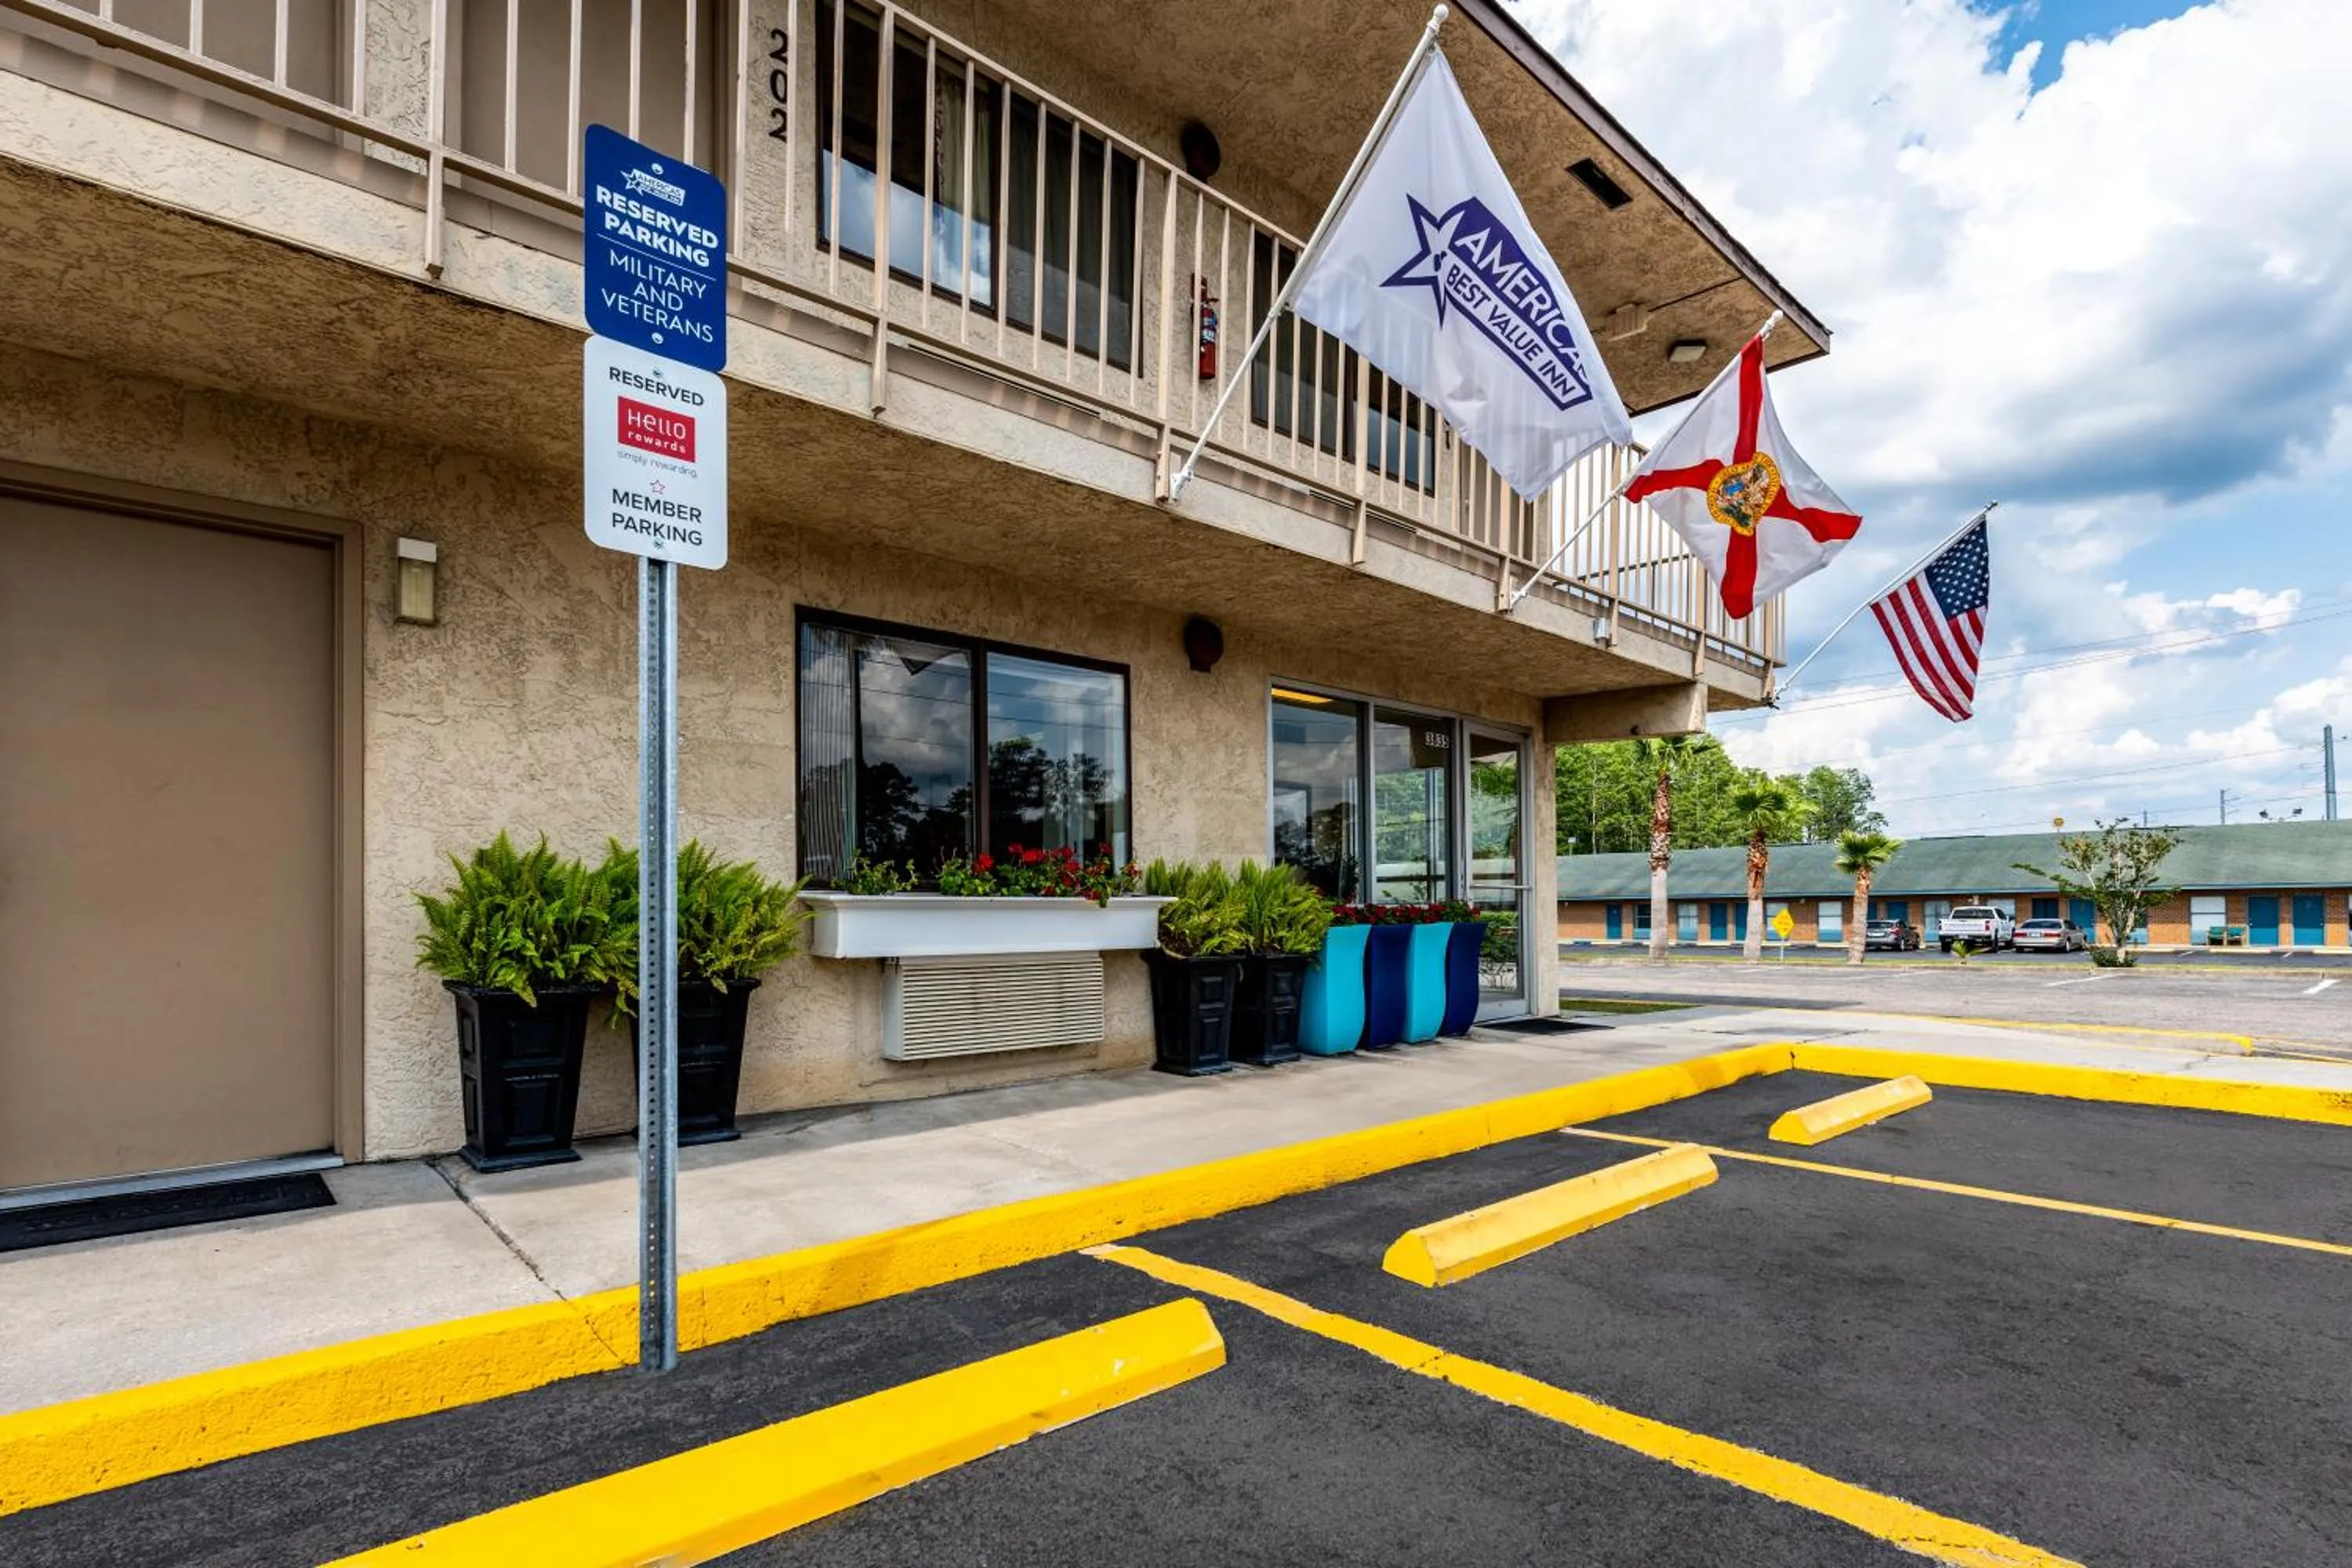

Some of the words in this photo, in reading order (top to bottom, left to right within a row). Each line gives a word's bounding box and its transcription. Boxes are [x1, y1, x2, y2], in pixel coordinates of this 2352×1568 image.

[768, 28, 787, 143] 202
[596, 184, 718, 249] RESERVED
[604, 212, 710, 267] PARKING
[609, 249, 706, 299] MILITARY
[601, 288, 713, 343] VETERANS
[633, 281, 683, 311] AND
[1446, 263, 1491, 309] BEST
[1487, 305, 1543, 361] VALUE
[1538, 359, 1576, 397] INN
[609, 366, 704, 406] RESERVED
[628, 408, 686, 440] Hello
[628, 430, 686, 454] rewards
[617, 450, 648, 466] simply
[612, 488, 702, 524] MEMBER
[612, 513, 702, 546] PARKING
